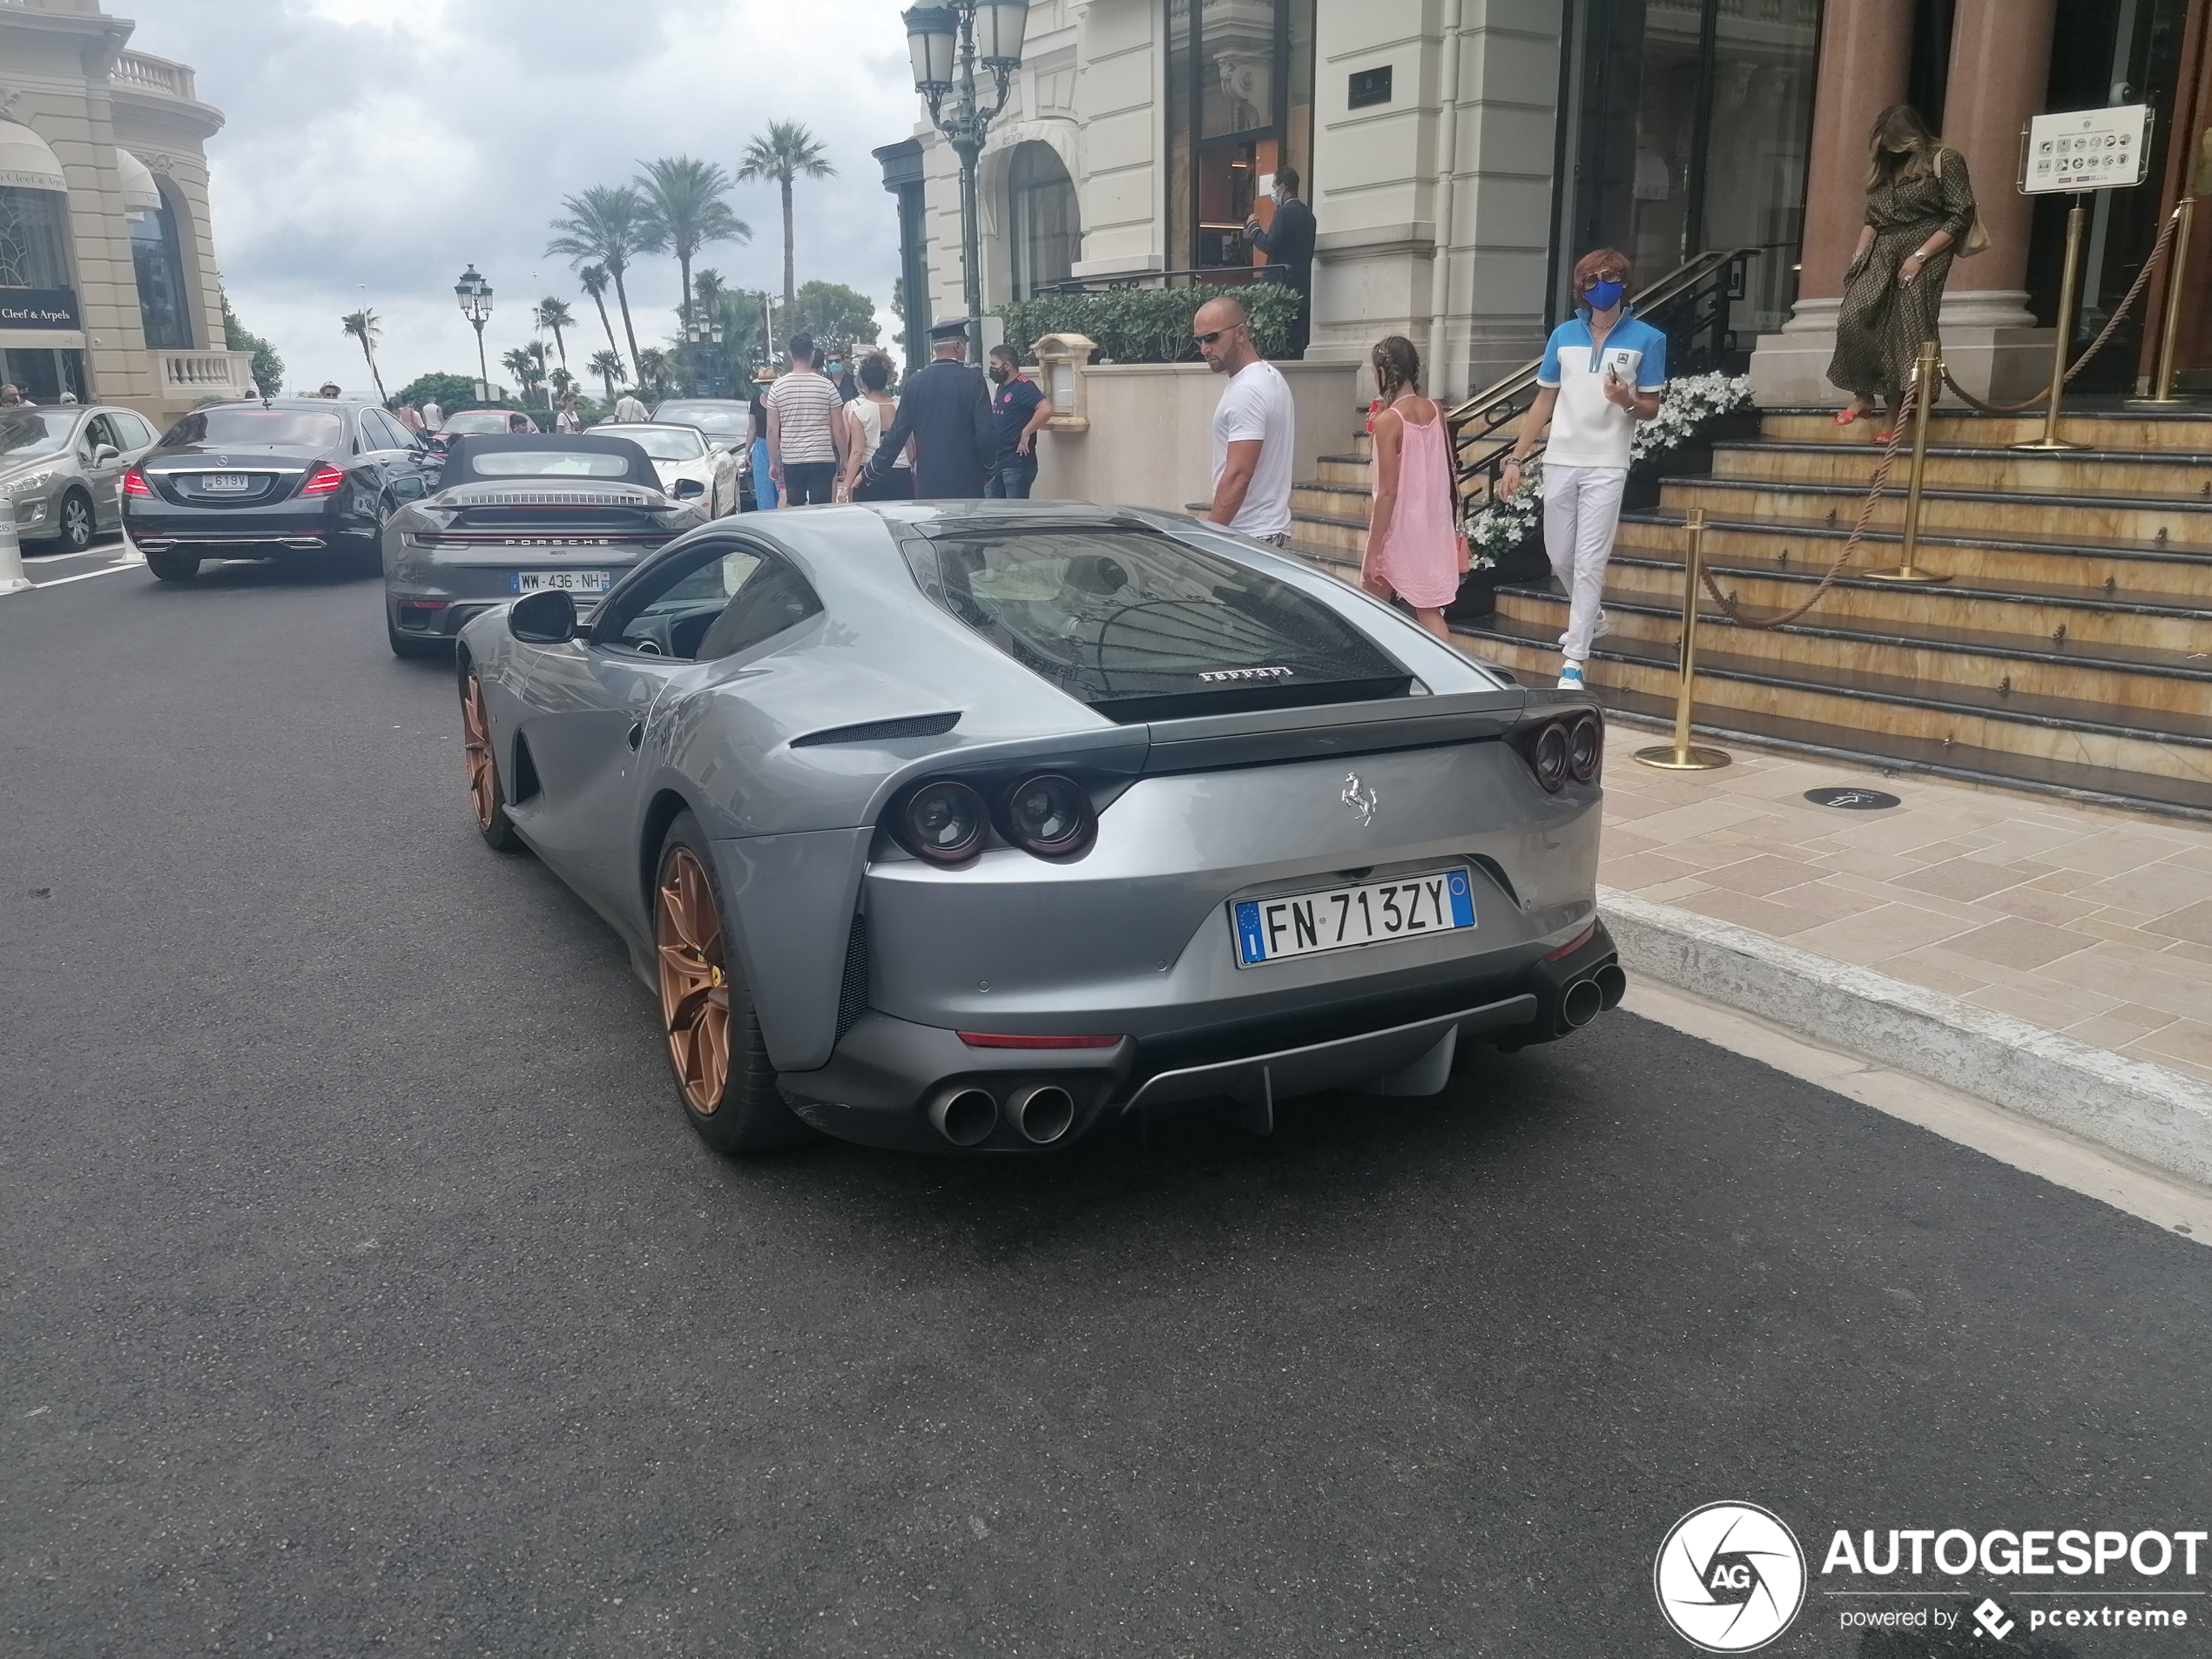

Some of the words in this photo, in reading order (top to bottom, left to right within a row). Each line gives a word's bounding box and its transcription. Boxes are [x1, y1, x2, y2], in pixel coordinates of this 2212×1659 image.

[7, 173, 35, 183] Cleef
[2, 308, 29, 319] Cleef
[40, 309, 71, 322] Arpels
[215, 475, 245, 486] 619V
[1265, 900, 1318, 954] FN
[1330, 880, 1445, 942] 713ZY
